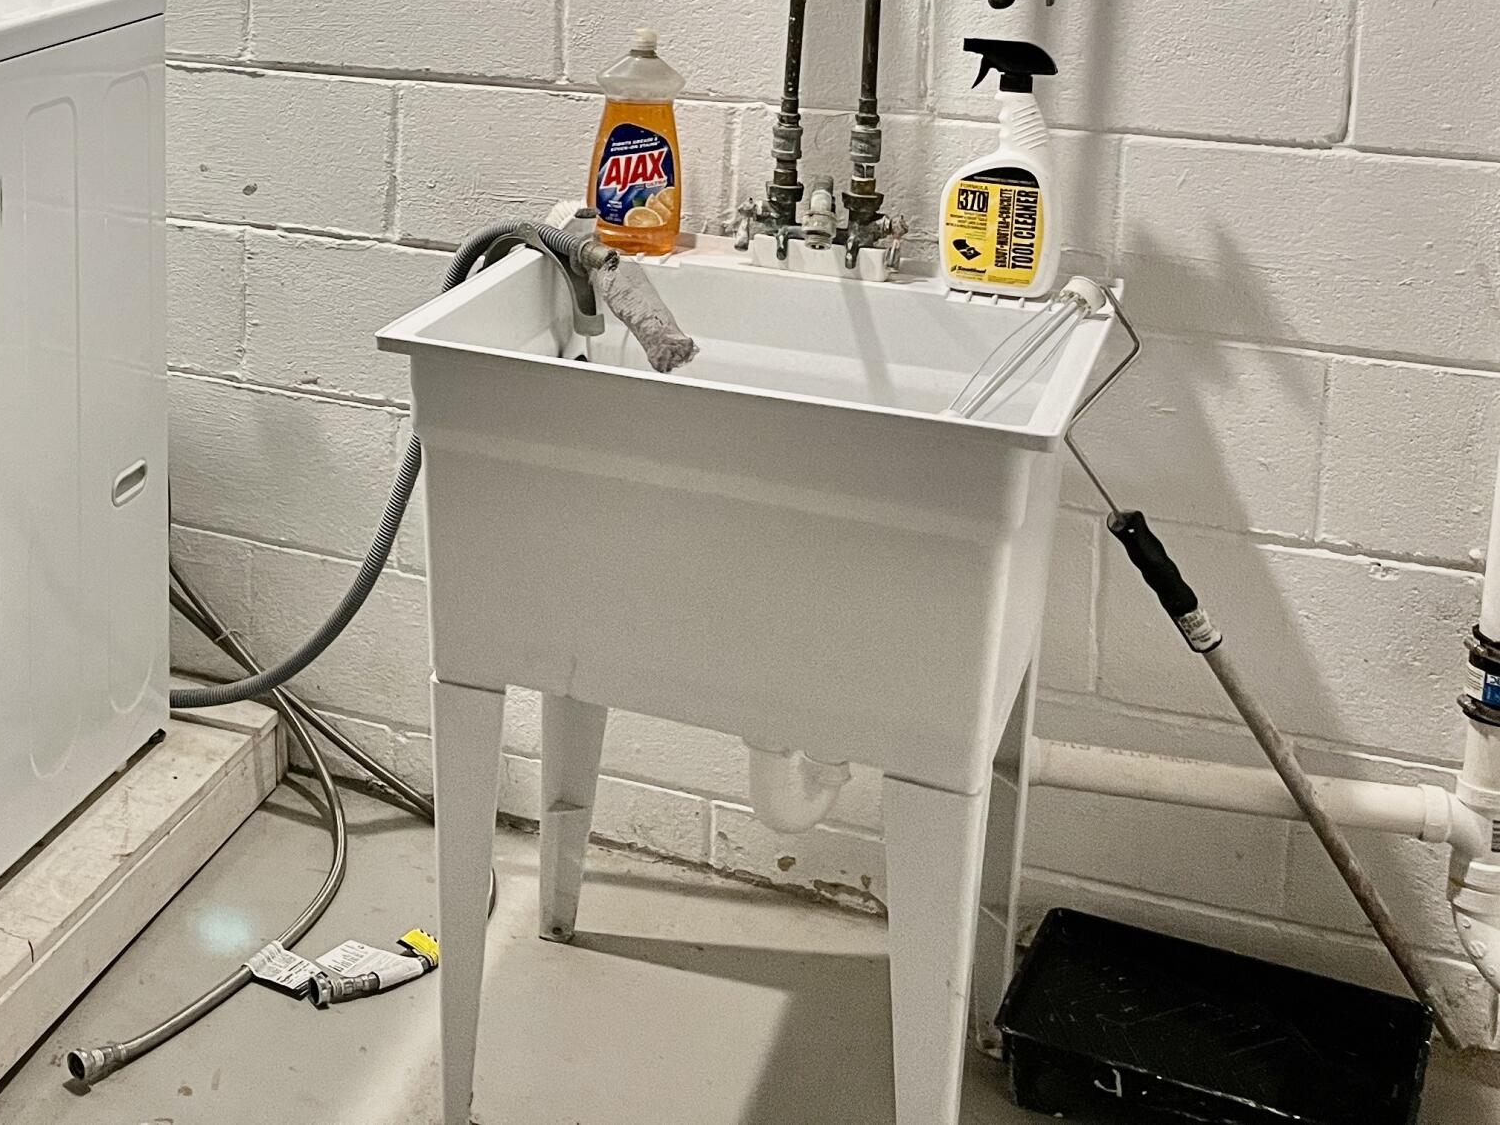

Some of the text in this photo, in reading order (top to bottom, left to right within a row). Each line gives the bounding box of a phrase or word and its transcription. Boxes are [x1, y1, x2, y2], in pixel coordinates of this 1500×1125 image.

[602, 150, 665, 192] AJAX
[959, 189, 988, 212] 370
[1011, 190, 1038, 270] TOOL CLEANER
